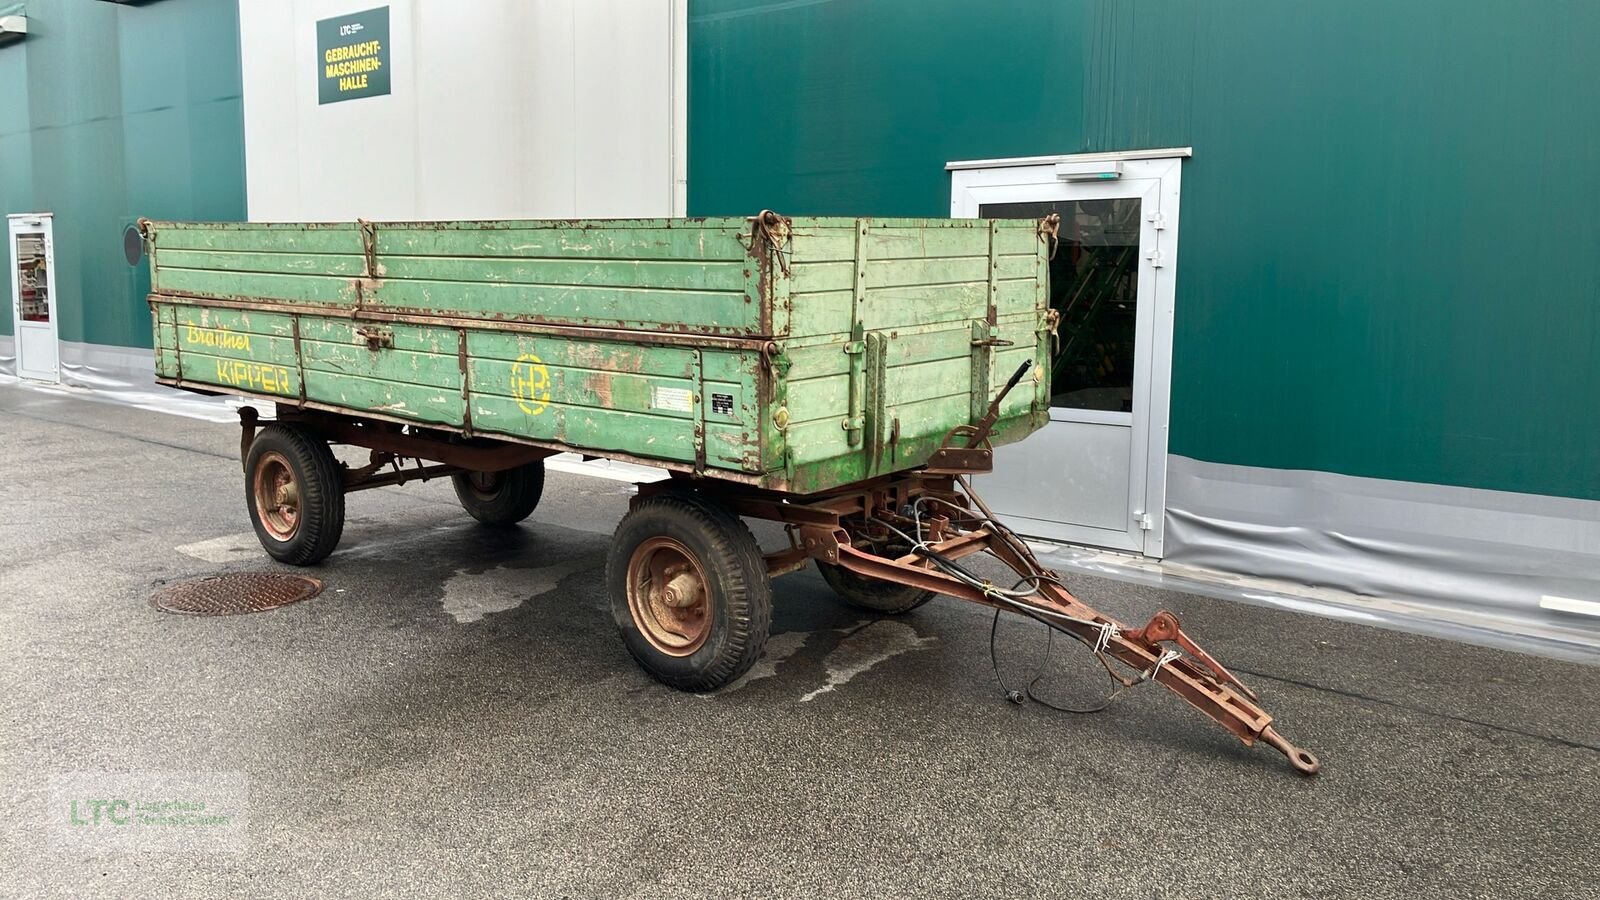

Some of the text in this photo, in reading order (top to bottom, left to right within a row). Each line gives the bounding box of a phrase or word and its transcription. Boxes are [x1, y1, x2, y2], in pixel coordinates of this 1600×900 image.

[340, 25, 351, 36] LTC
[325, 40, 381, 63] GEBRAUCHT-
[326, 57, 381, 79] MASCHINEN-
[339, 74, 368, 91] HALLE
[216, 359, 290, 394] KIPPER
